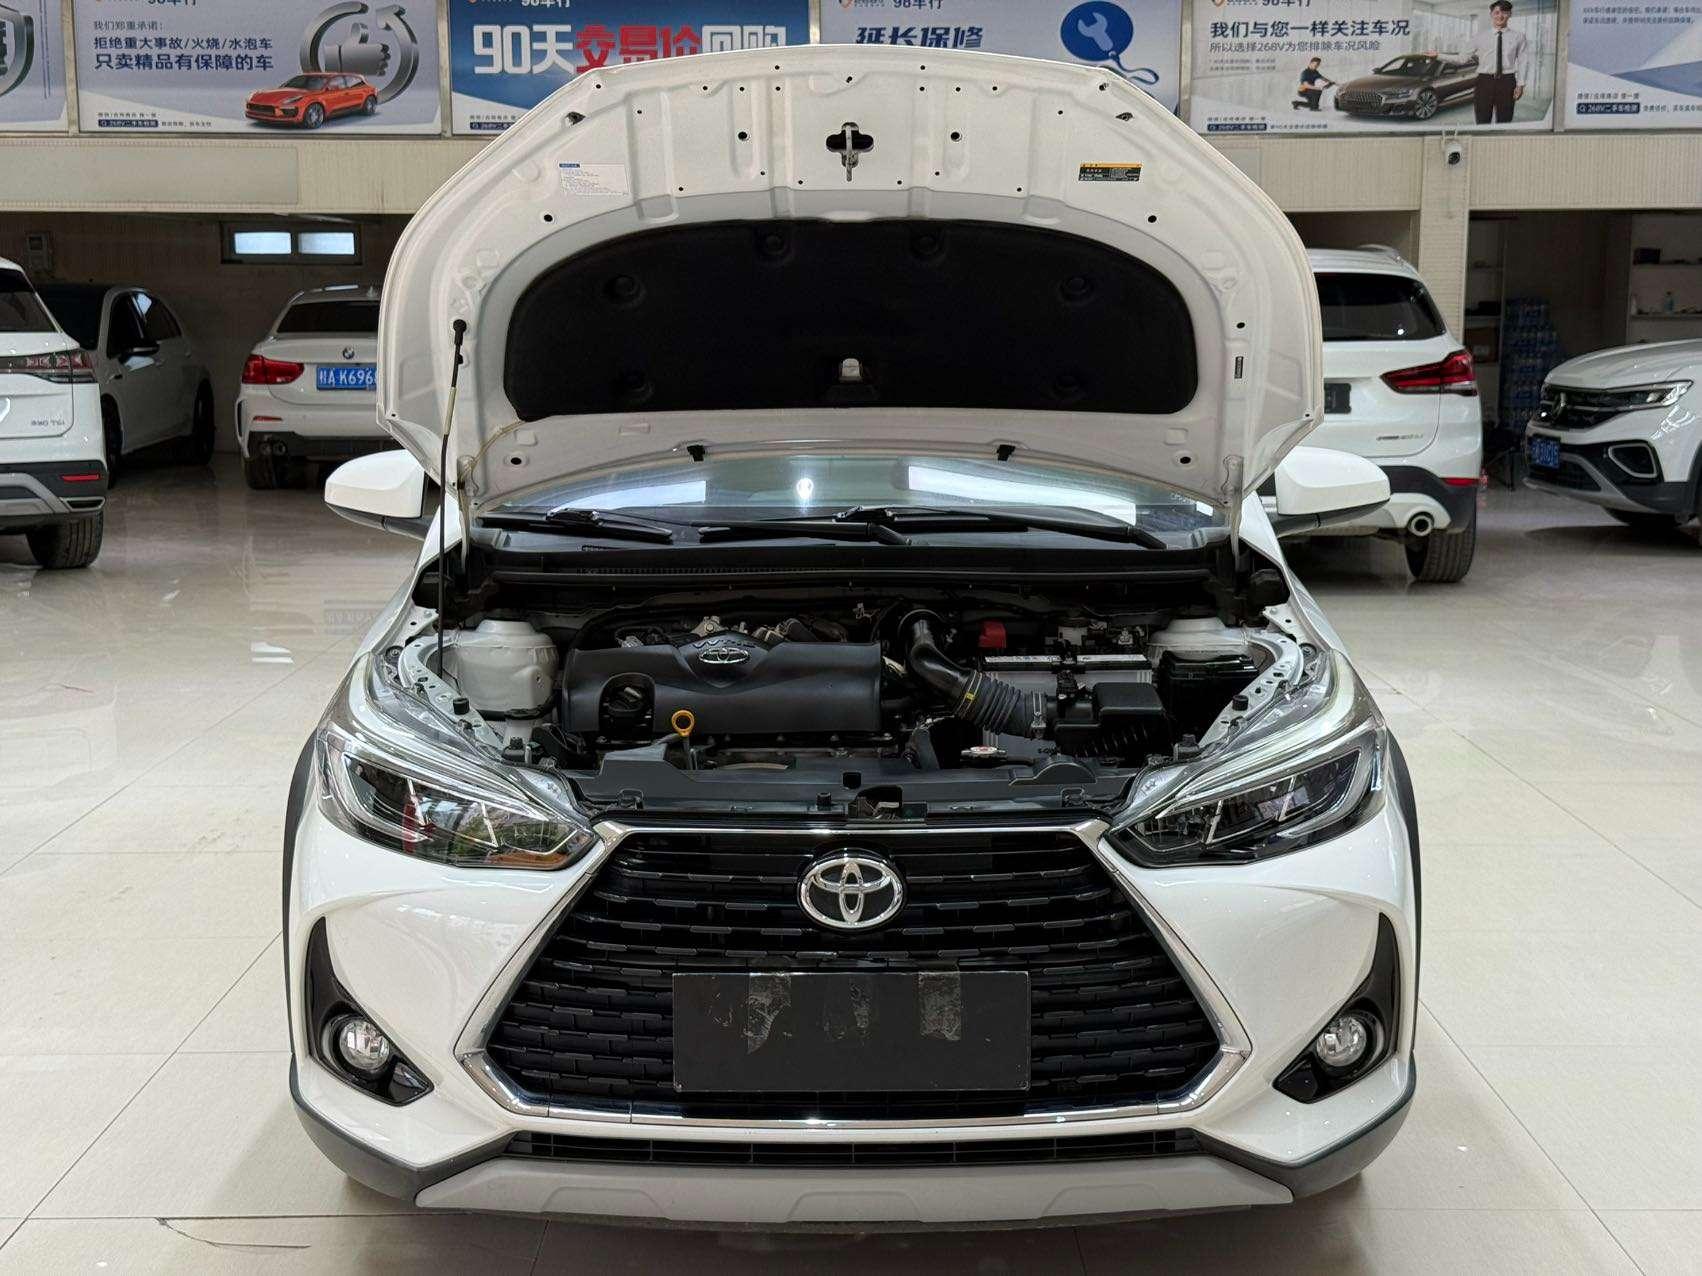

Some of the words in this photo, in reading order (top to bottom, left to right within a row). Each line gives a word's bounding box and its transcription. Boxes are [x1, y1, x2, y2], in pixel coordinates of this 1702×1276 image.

[856, 26, 984, 48] 延长保修
[1210, 20, 1410, 38] 我们与您一样关注车况
[94, 37, 273, 50] 拒绝重大事故/火烧/水泡车
[95, 53, 274, 71] 只卖精品有保障的车
